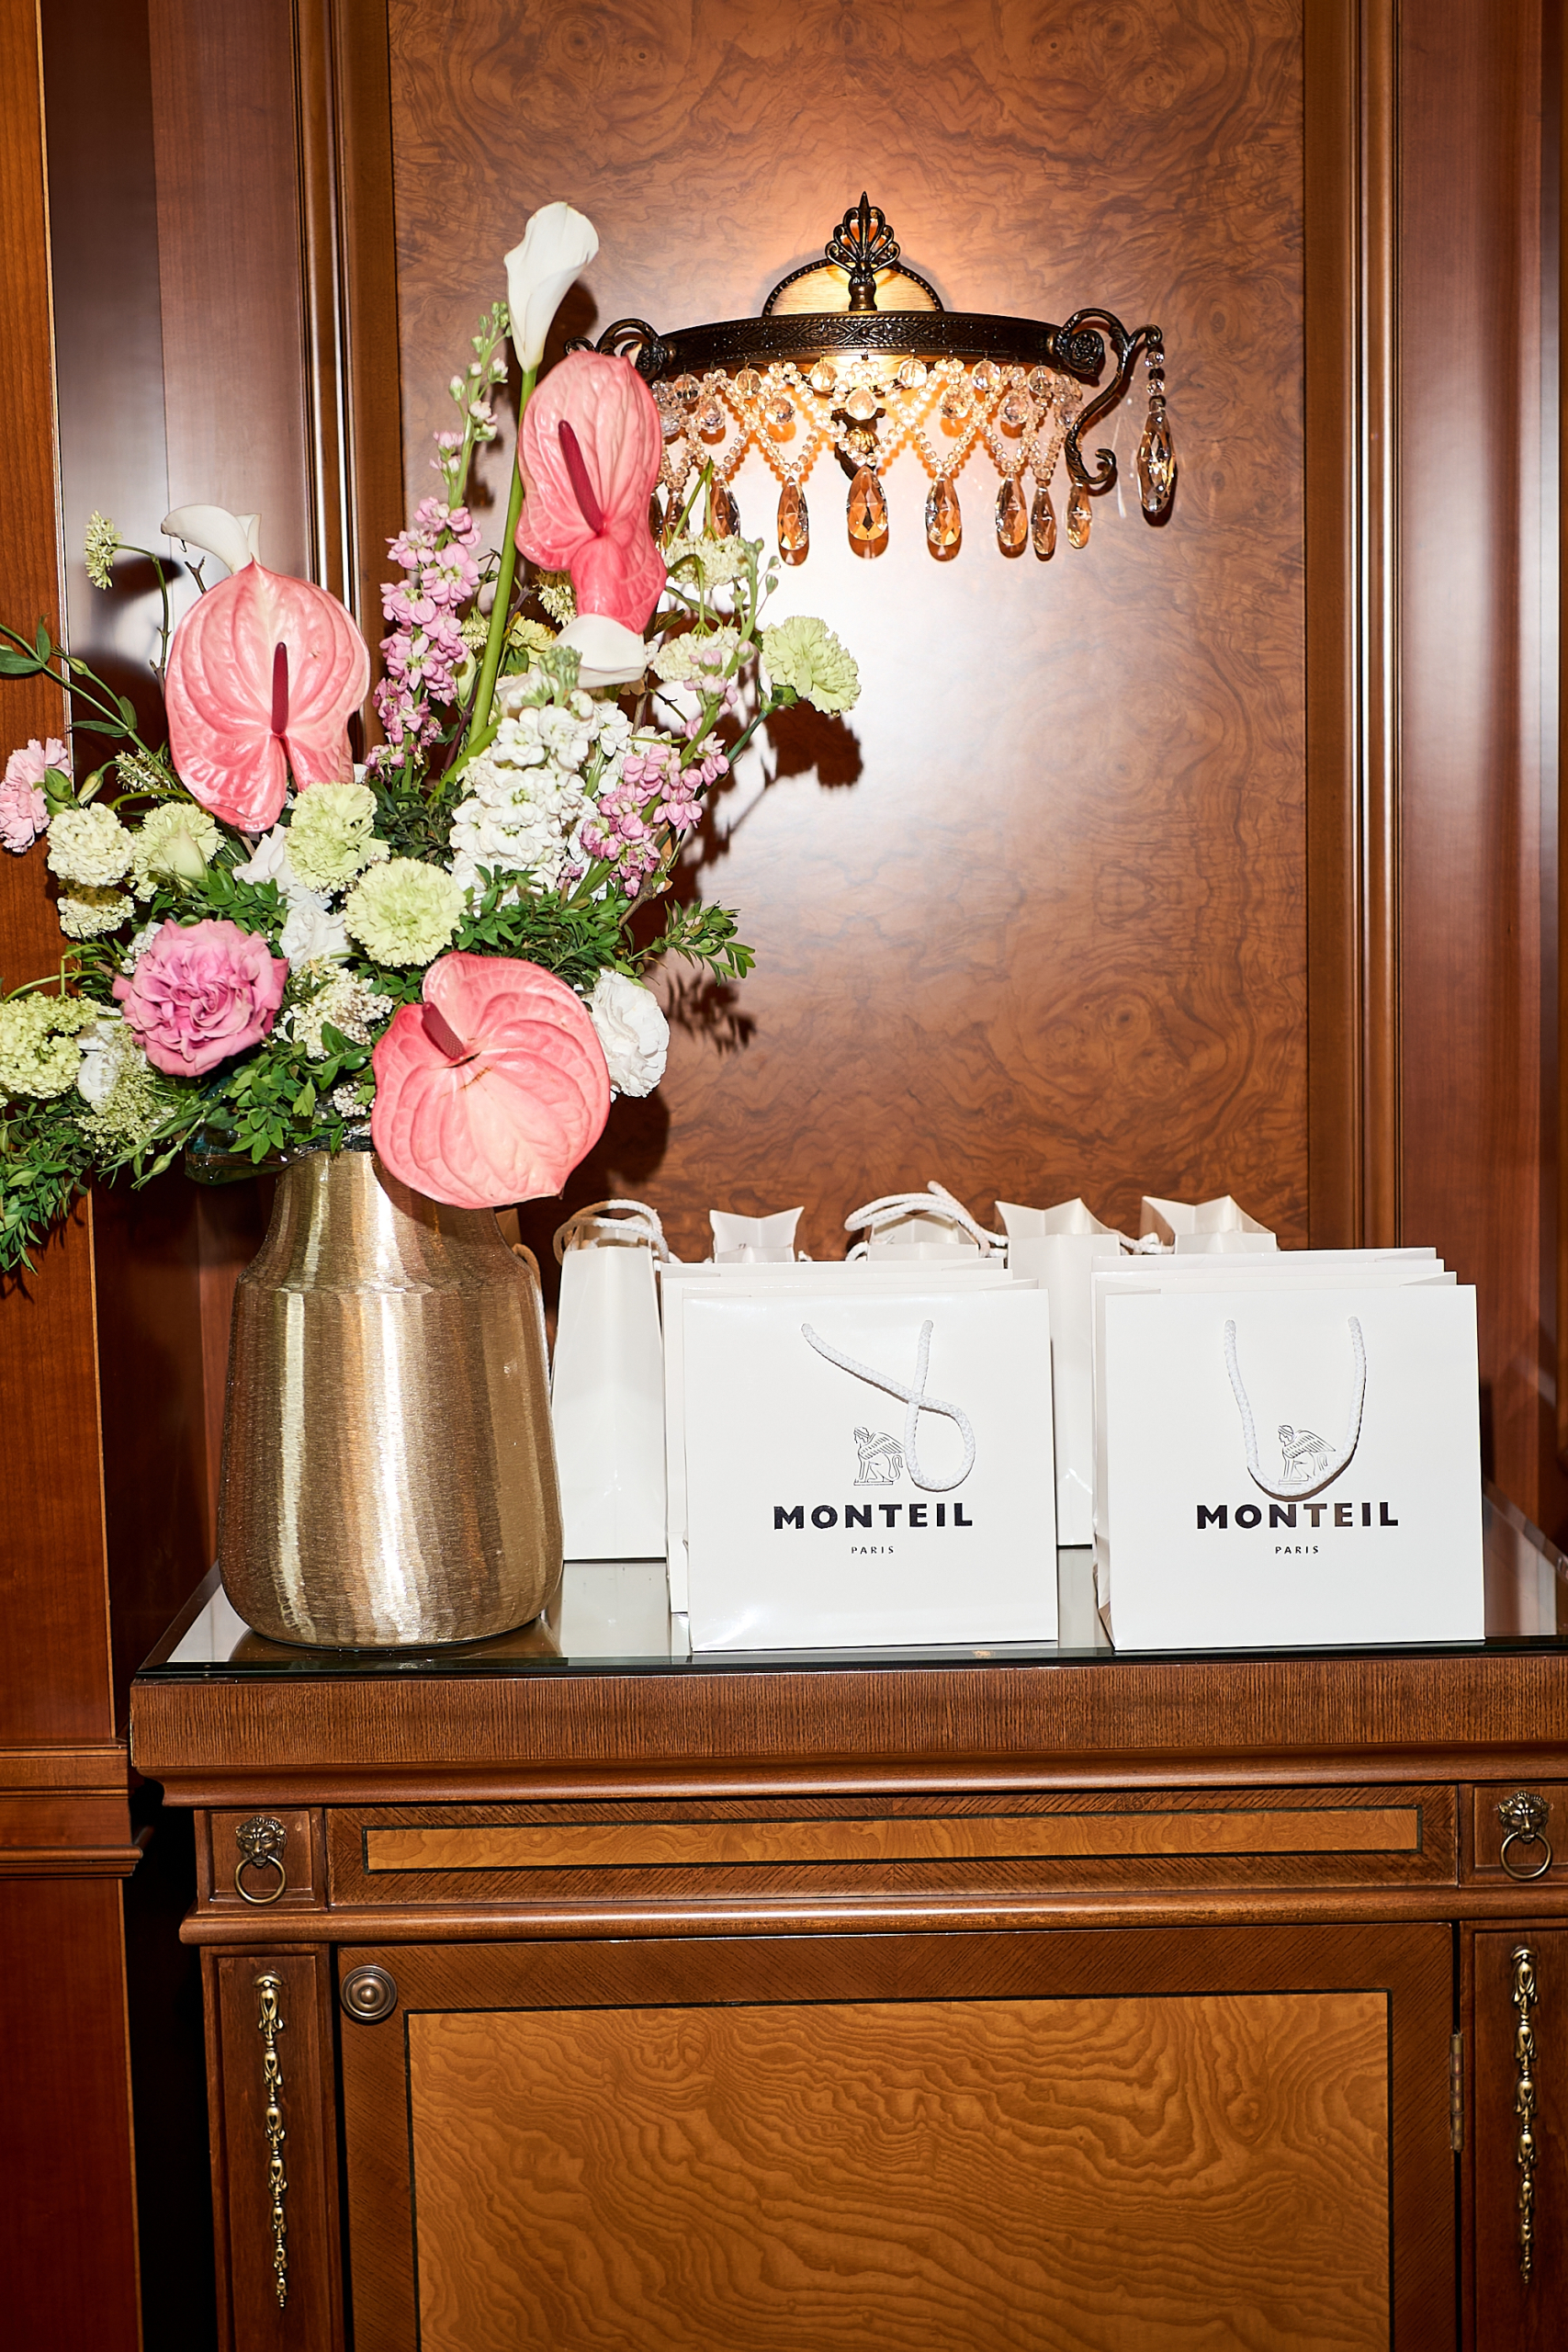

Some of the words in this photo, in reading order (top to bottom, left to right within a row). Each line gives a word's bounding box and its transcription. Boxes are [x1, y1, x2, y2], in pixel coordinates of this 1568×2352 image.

[773, 1502, 973, 1530] MONTEIL
[1196, 1501, 1399, 1530] MONTEIL
[851, 1545, 895, 1555] PARIS
[1275, 1545, 1319, 1555] PARIS
